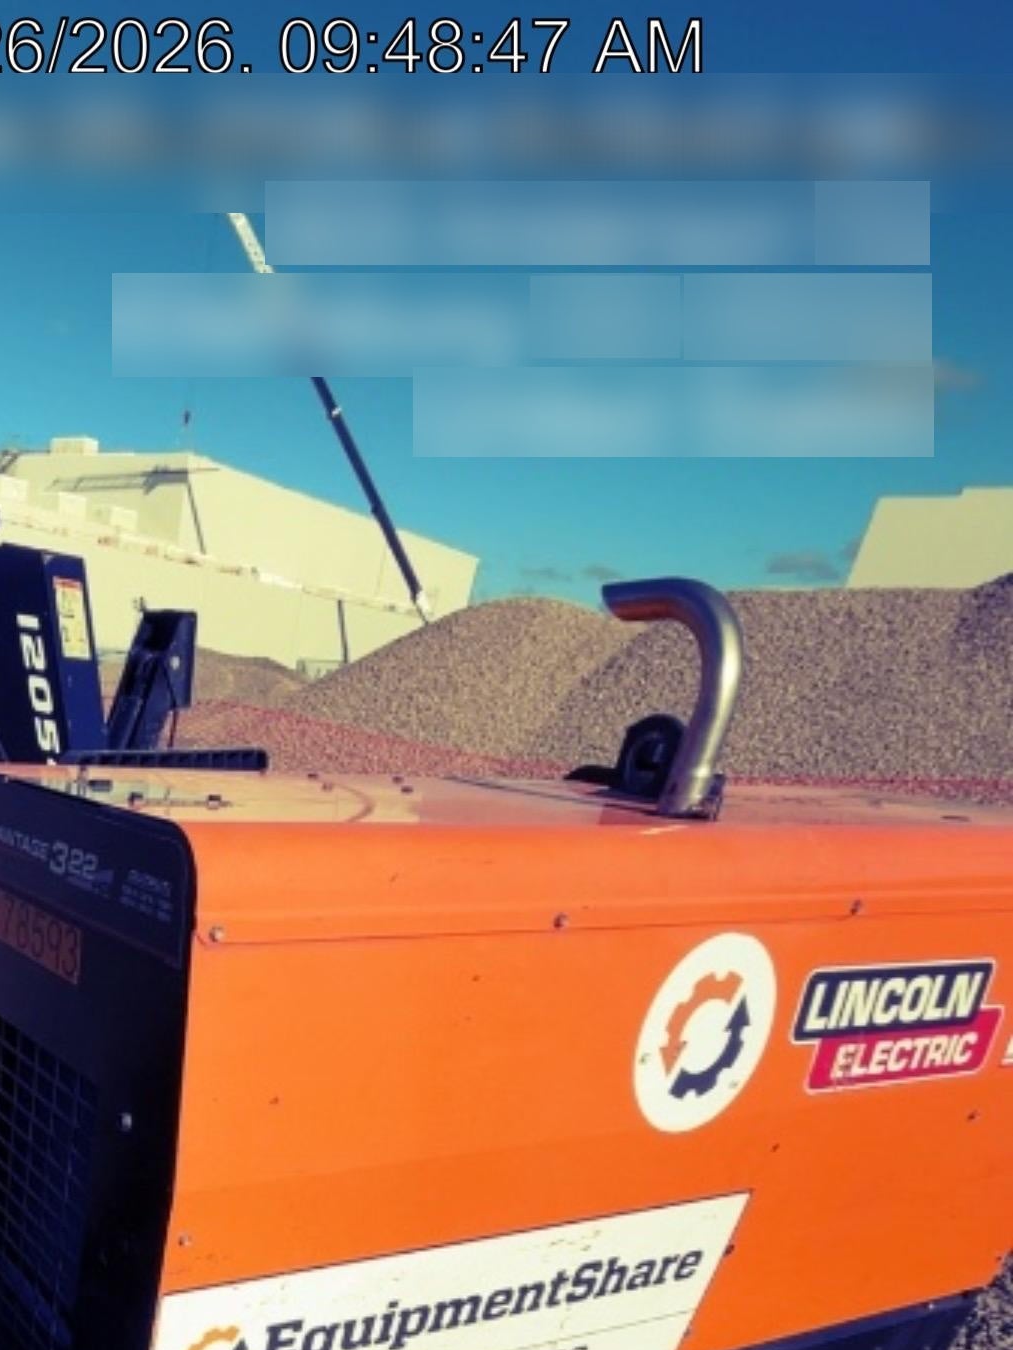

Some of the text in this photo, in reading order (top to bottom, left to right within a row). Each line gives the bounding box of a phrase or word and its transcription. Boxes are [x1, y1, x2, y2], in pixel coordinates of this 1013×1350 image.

[16, 613, 60, 766] 1205
[48, 840, 100, 880] 322
[803, 971, 985, 1031] LINCOLN
[830, 1031, 979, 1079] ELECTRIC
